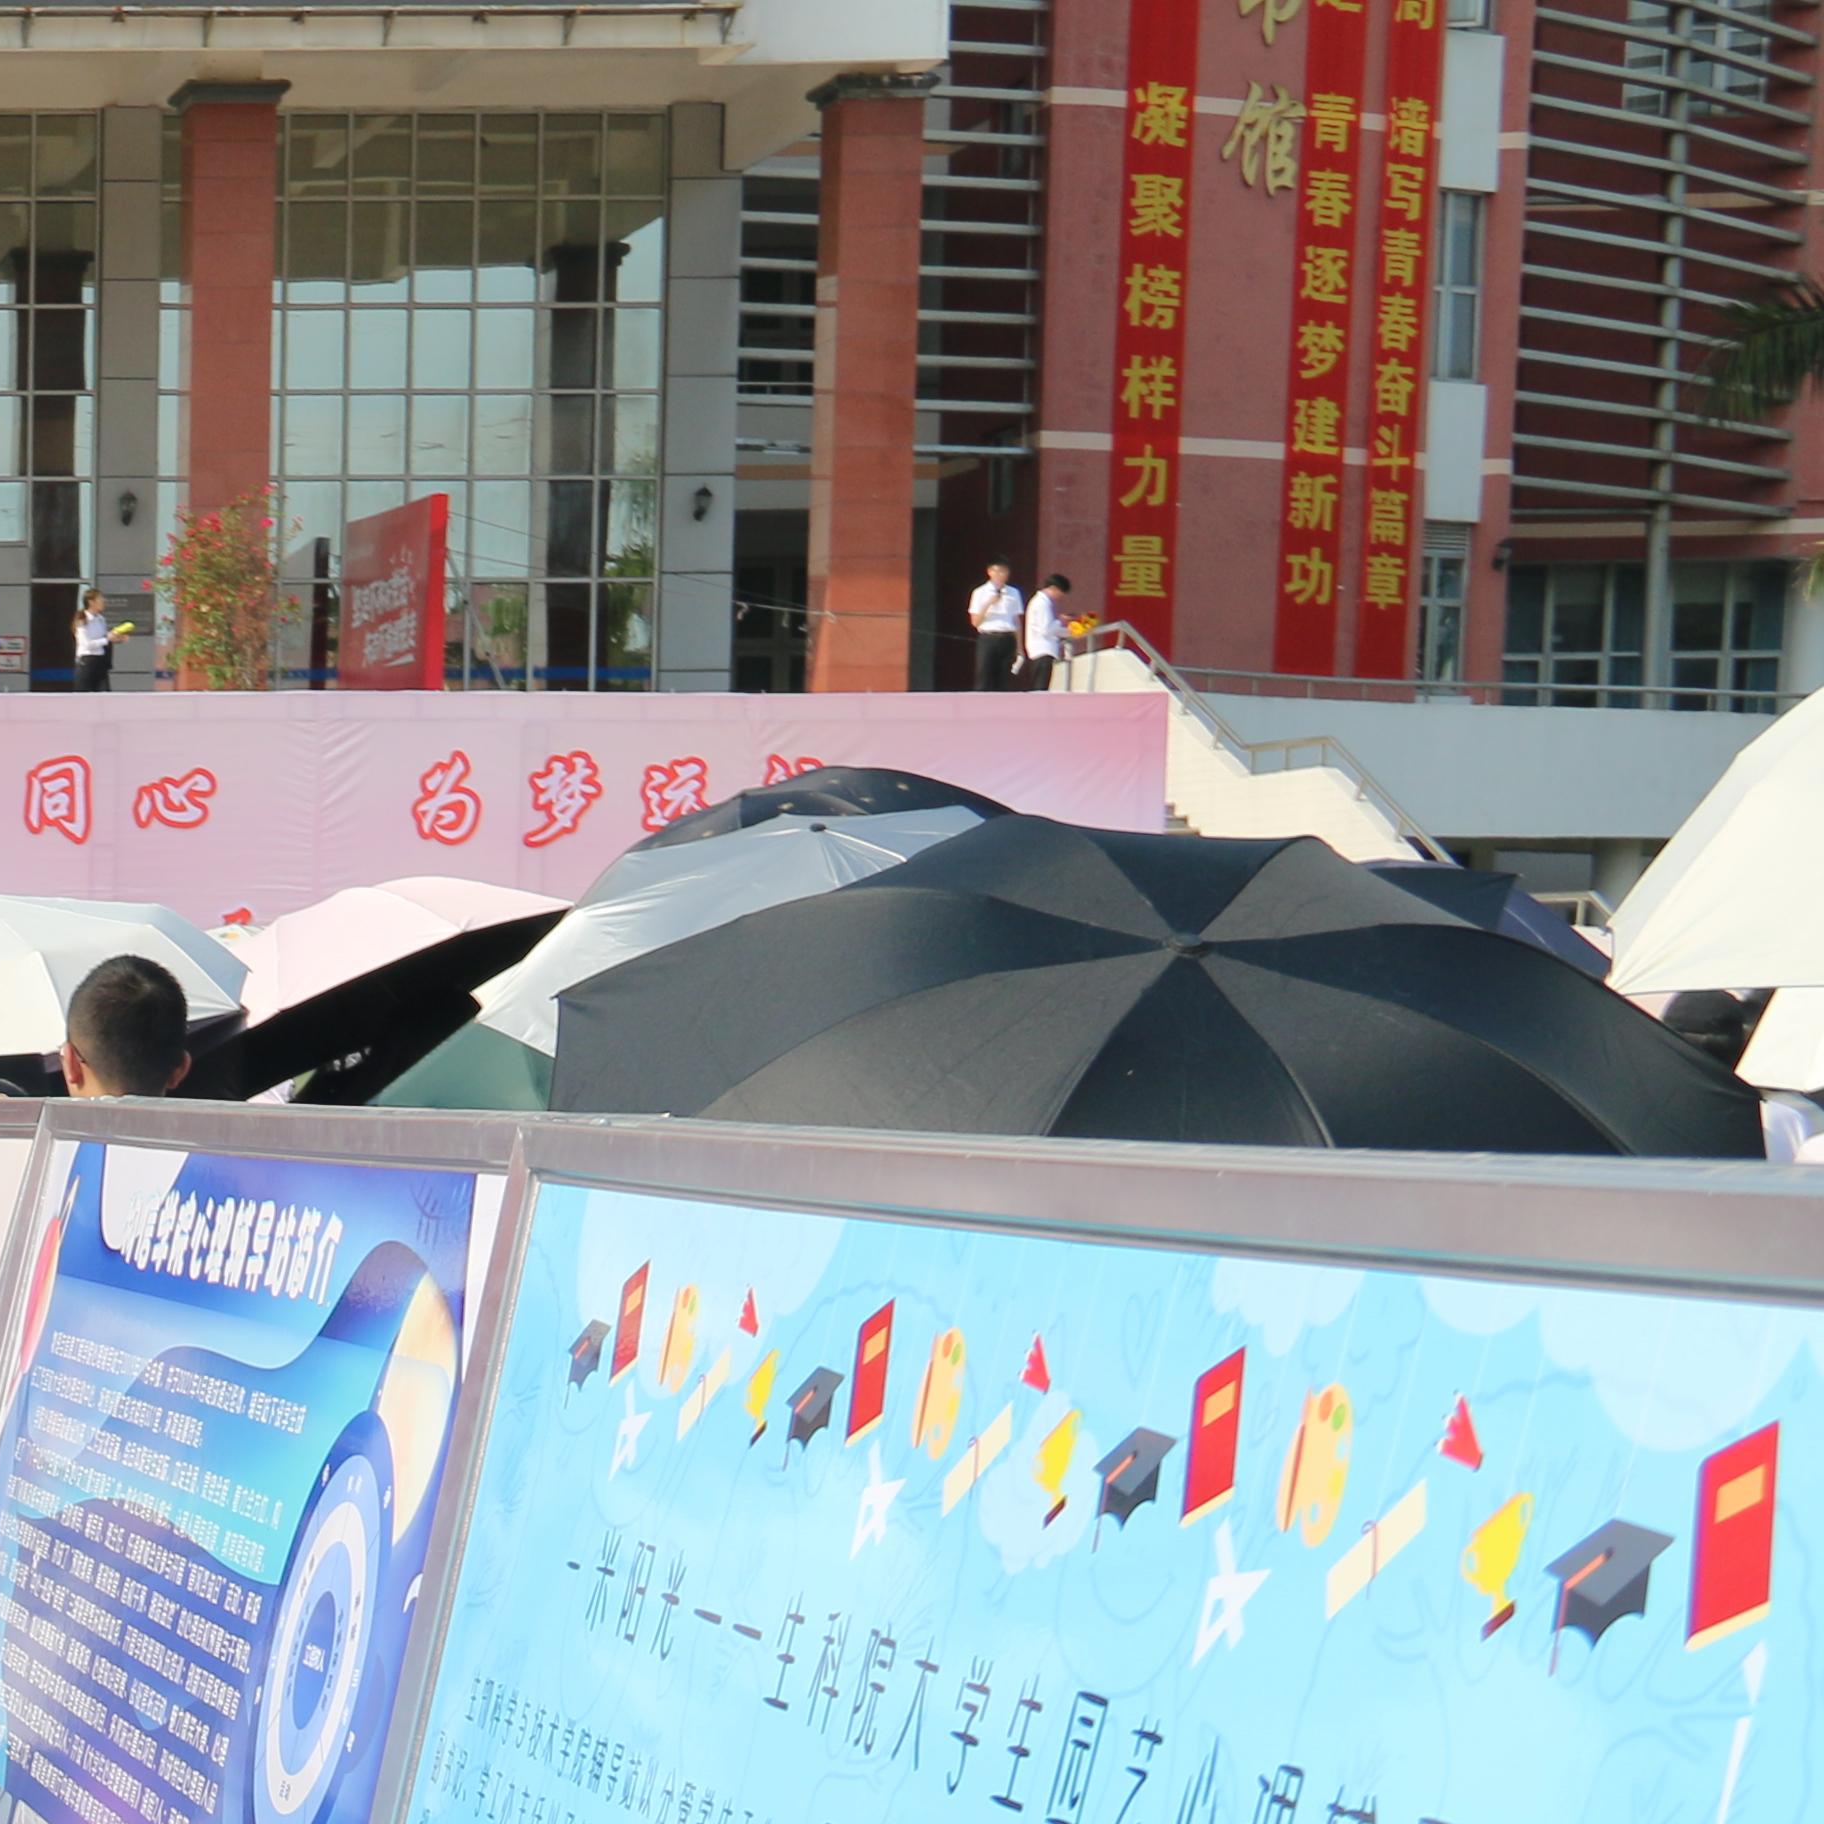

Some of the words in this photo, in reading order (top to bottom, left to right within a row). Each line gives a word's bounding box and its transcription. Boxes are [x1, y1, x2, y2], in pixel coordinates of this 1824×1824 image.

[1112, 81, 1188, 598] 凝聚榜样力量
[1285, 91, 1357, 605] 青春逐梦建新功
[1365, 96, 1431, 611] 谱写青春奋斗篇章
[412, 749, 824, 849] 为梦远
